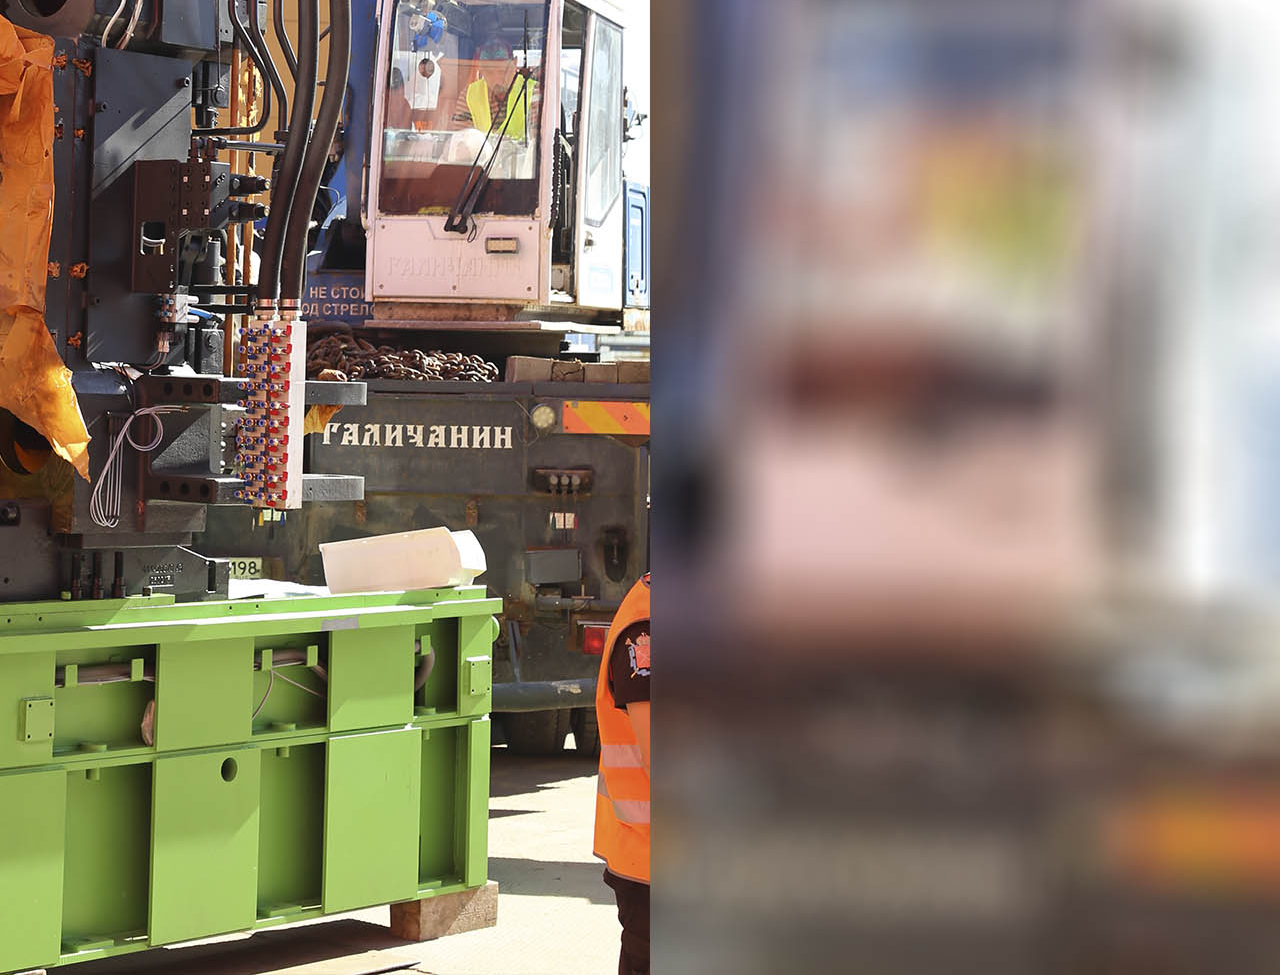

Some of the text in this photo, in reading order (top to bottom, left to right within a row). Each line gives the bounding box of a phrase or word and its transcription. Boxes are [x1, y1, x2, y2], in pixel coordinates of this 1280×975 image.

[309, 287, 327, 299] НЕ
[322, 422, 513, 449] ГАЛИЧАНИН
[231, 561, 257, 575] 198
